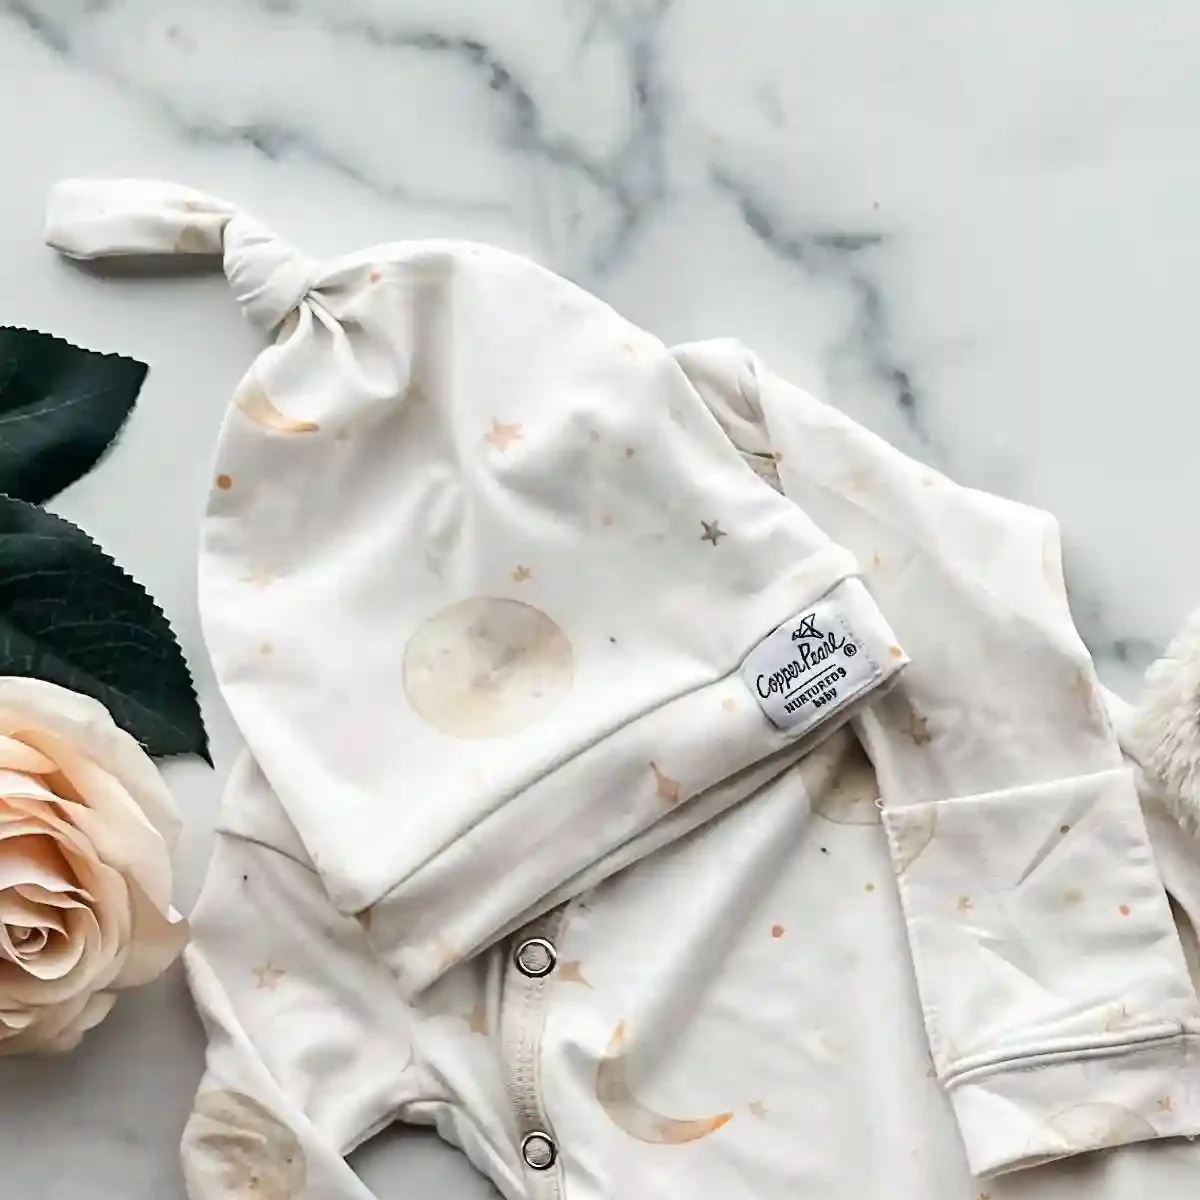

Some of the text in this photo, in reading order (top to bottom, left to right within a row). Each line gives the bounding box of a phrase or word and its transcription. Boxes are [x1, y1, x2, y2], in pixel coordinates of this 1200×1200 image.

[756, 632, 846, 699] Copper Pearl
[811, 688, 838, 708] baby
